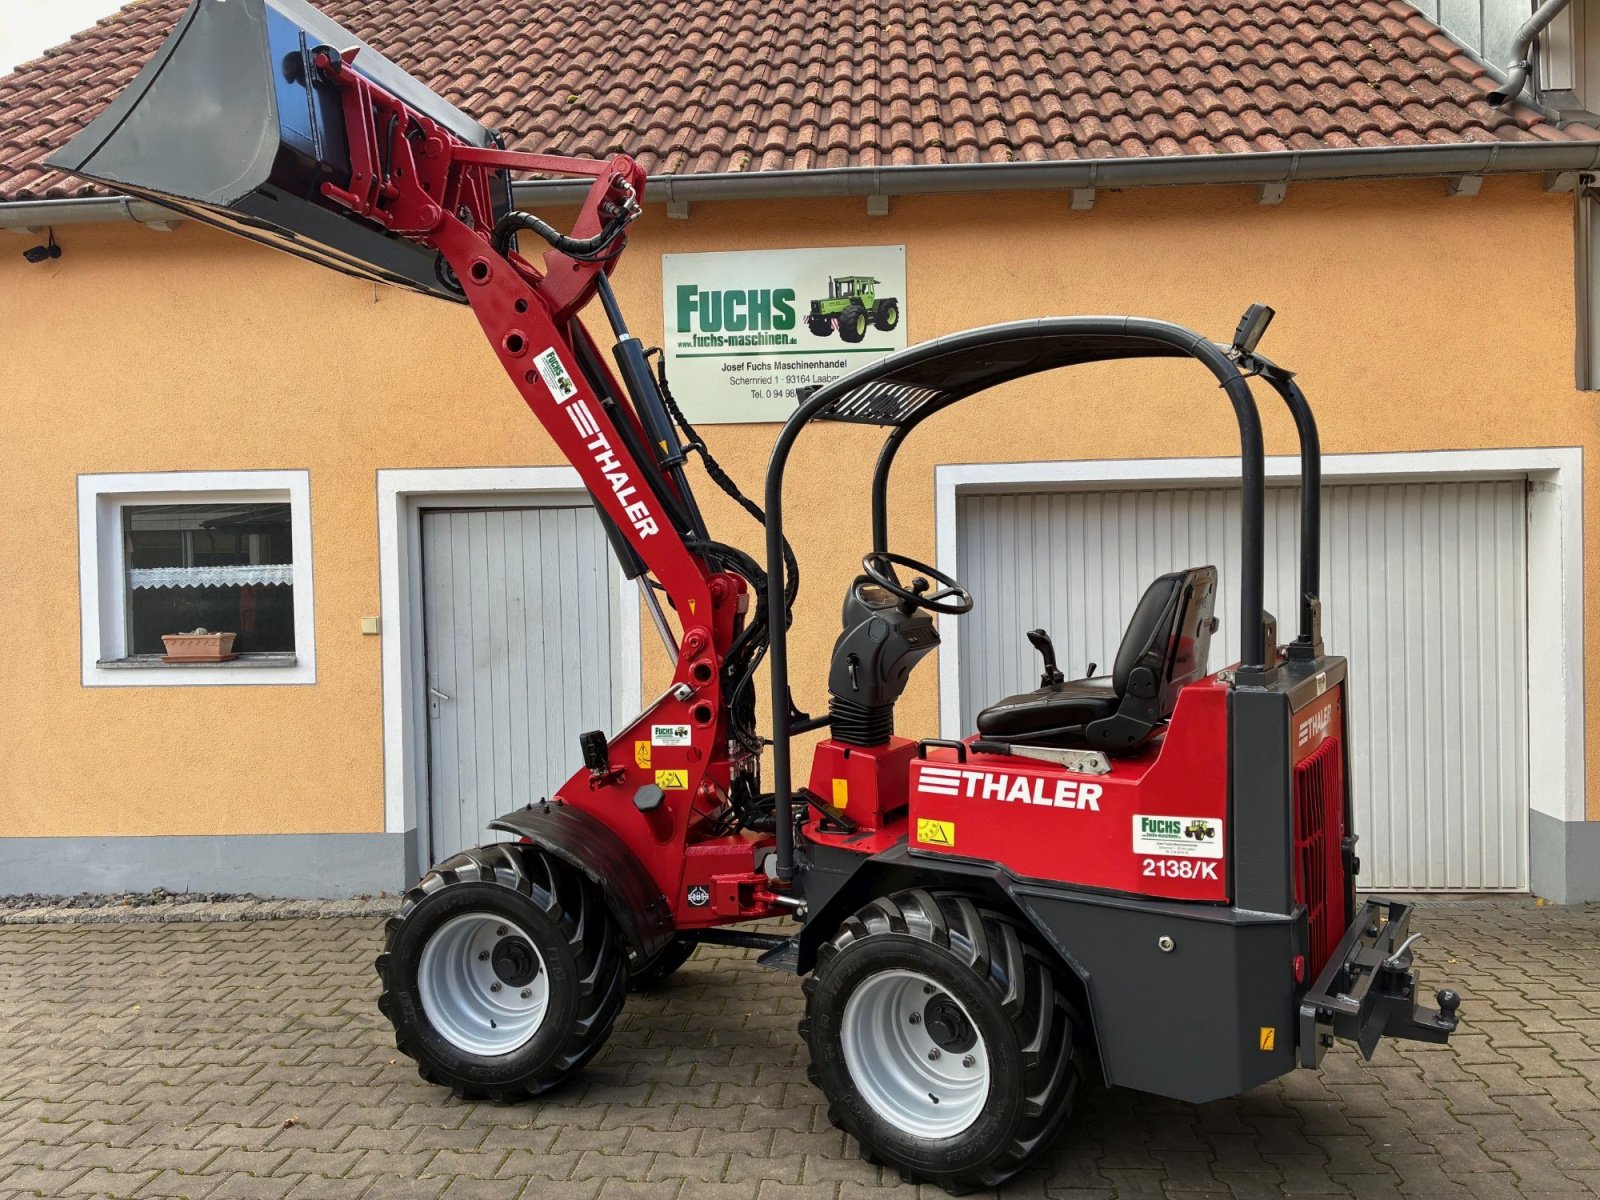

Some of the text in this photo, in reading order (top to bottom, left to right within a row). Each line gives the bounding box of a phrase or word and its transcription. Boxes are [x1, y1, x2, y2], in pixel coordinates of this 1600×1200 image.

[676, 284, 796, 333] FUCHS
[677, 331, 798, 348] www.fuchs-maschinen.de
[721, 359, 848, 372] Josef Fuchs Maschinenhandel
[729, 376, 772, 386] Schernried
[774, 376, 779, 384] 1
[785, 374, 810, 384] 93164
[750, 389, 764, 399] Tel.
[766, 390, 772, 398] 0
[773, 389, 783, 398] 94
[587, 431, 660, 540] THALER
[1307, 703, 1332, 739] THALER
[960, 769, 1103, 811] THALER
[1141, 817, 1182, 834] FUCHS
[1142, 858, 1219, 880] 2138/K
